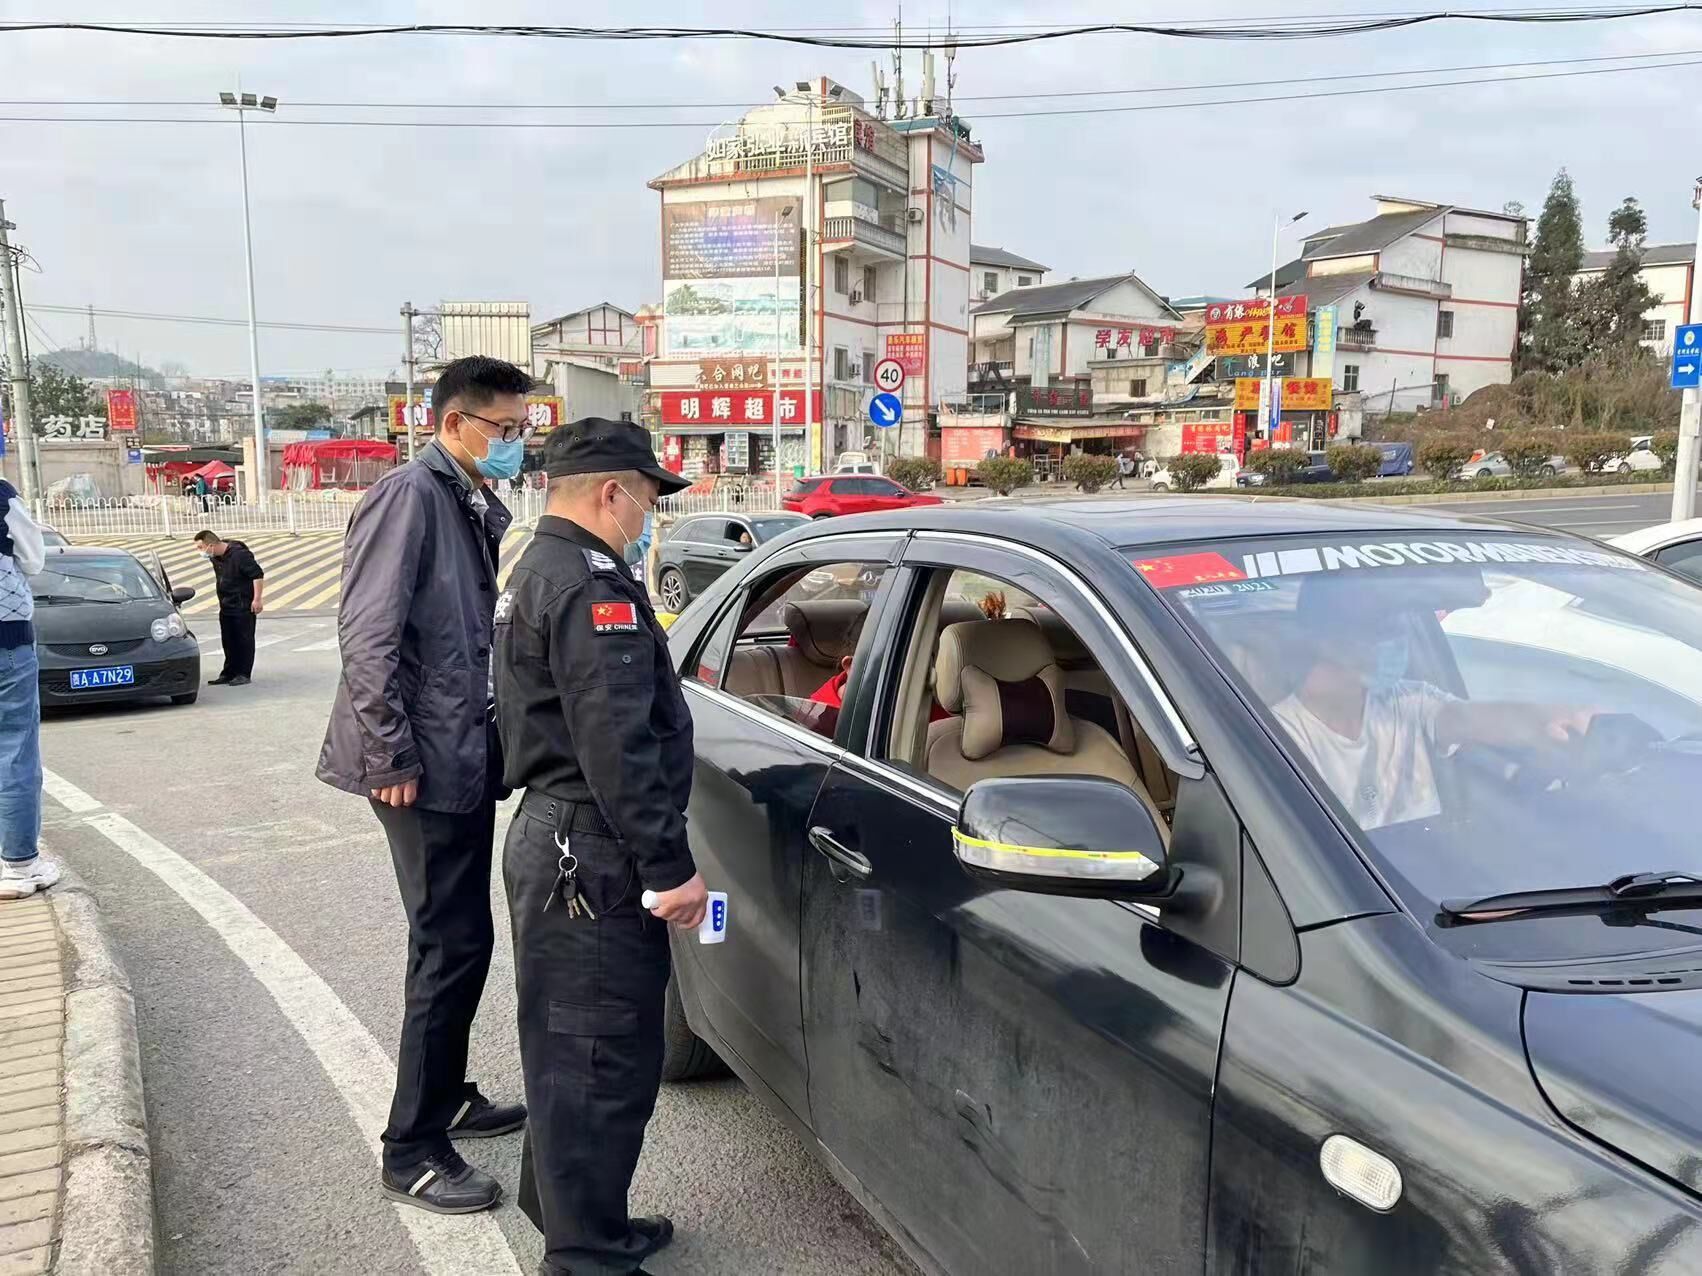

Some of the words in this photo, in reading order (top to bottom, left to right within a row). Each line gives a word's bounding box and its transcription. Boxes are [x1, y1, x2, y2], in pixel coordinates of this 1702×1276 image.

[1095, 326, 1176, 348] 学友超市
[695, 364, 763, 382] 六合网吧
[881, 368, 898, 383] 40
[680, 396, 797, 419] 明辉超市
[41, 414, 107, 438] 药店
[1187, 584, 1223, 596] 2020
[1232, 581, 1272, 593] 2021
